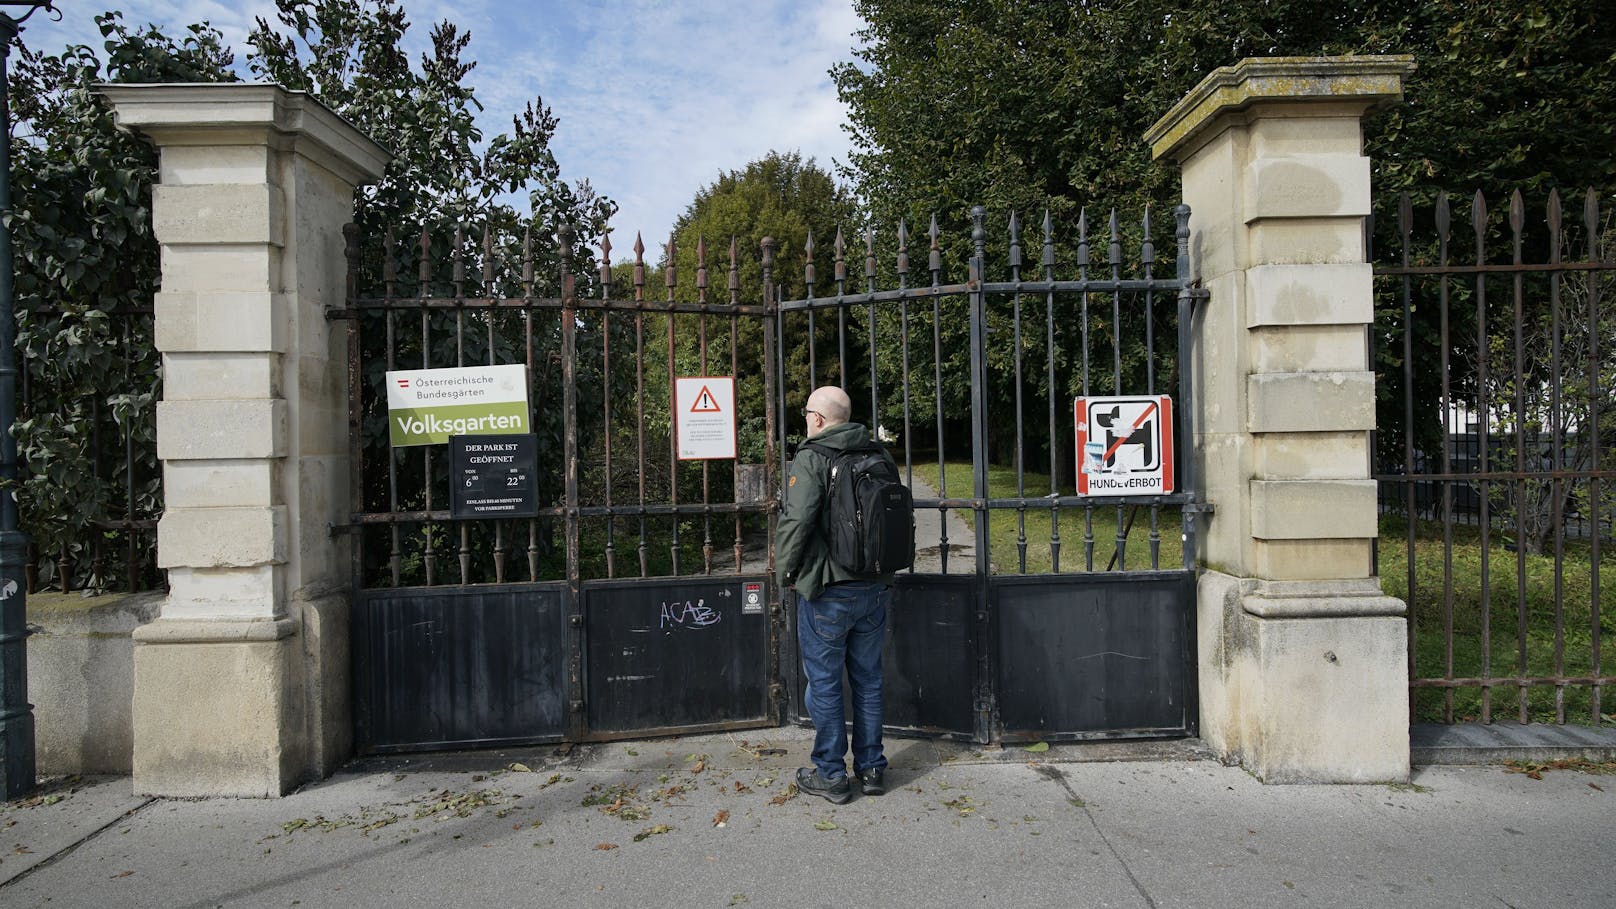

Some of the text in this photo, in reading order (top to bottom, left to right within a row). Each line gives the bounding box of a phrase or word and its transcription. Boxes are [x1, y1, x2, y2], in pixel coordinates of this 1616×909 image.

[415, 375, 494, 387] Österreichische
[416, 388, 485, 400] Bundesgärten
[397, 413, 521, 435] Volksgarten
[465, 444, 482, 452] DER
[505, 443, 518, 451] IST
[470, 455, 514, 464] GEÖFFNET
[1089, 477, 1162, 488] HUNDEVERBOT
